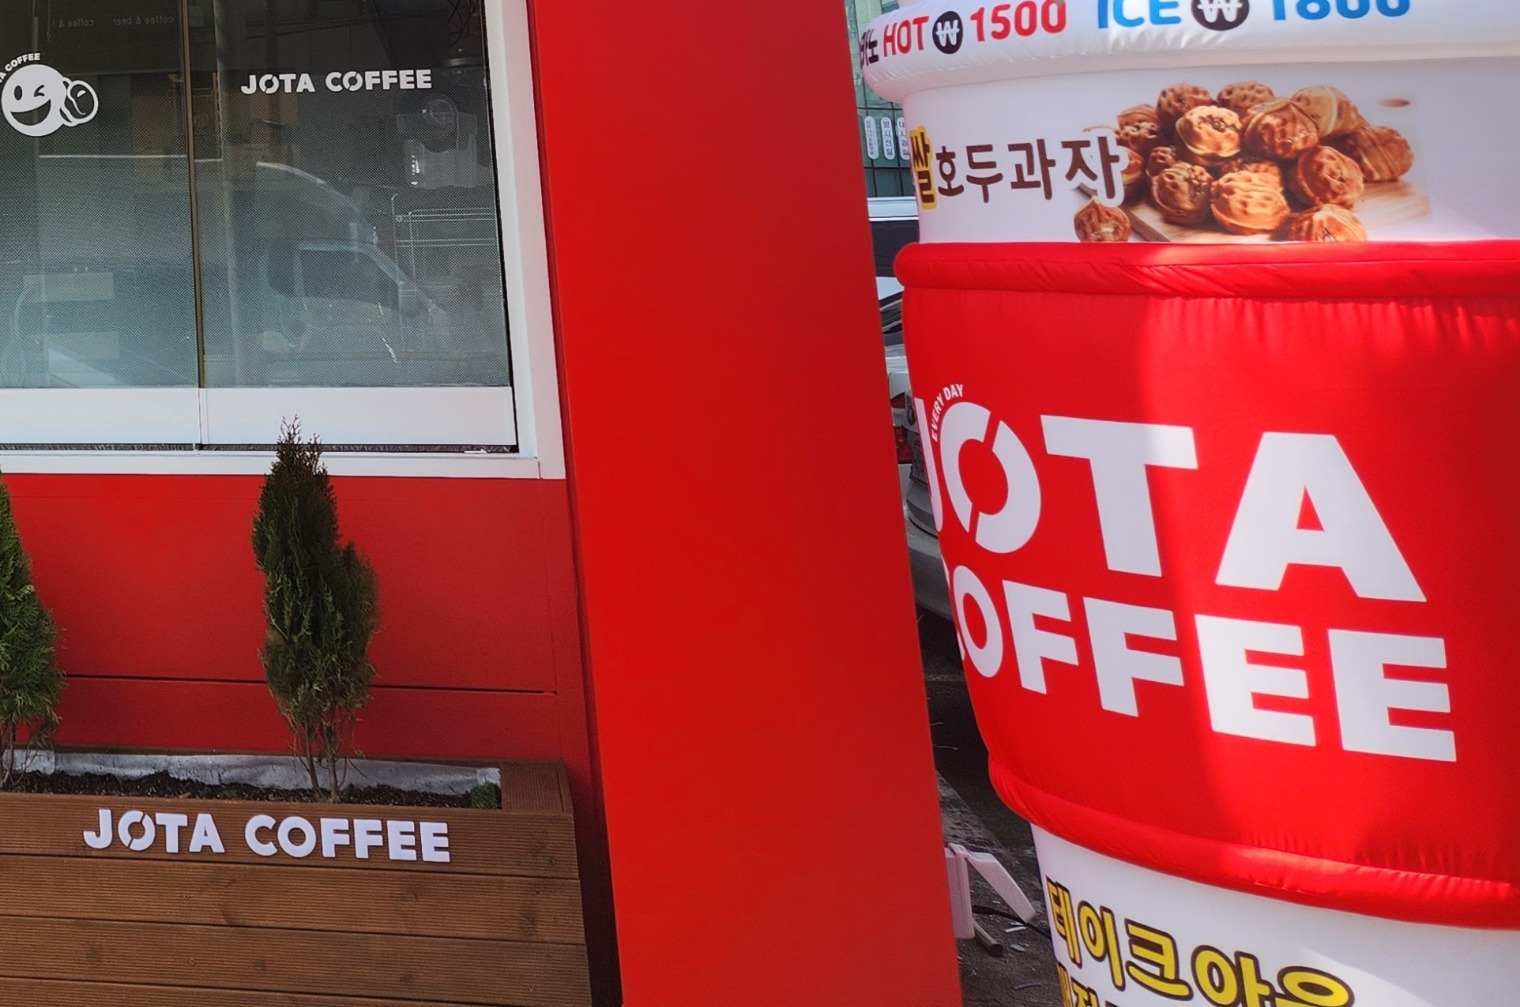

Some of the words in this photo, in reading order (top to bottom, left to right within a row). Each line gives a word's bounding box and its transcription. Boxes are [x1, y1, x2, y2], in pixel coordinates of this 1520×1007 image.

[5, 52, 41, 73] COFFEE
[883, 16, 930, 57] HOT
[240, 73, 316, 95] JOTA
[325, 69, 432, 92] COFFEE
[935, 135, 1123, 204] 호두과자
[931, 393, 944, 442] EVERY
[943, 384, 964, 400] DAY
[941, 555, 1458, 762] OFFEE
[82, 808, 225, 853] JOTA
[244, 814, 451, 862] COFFEE
